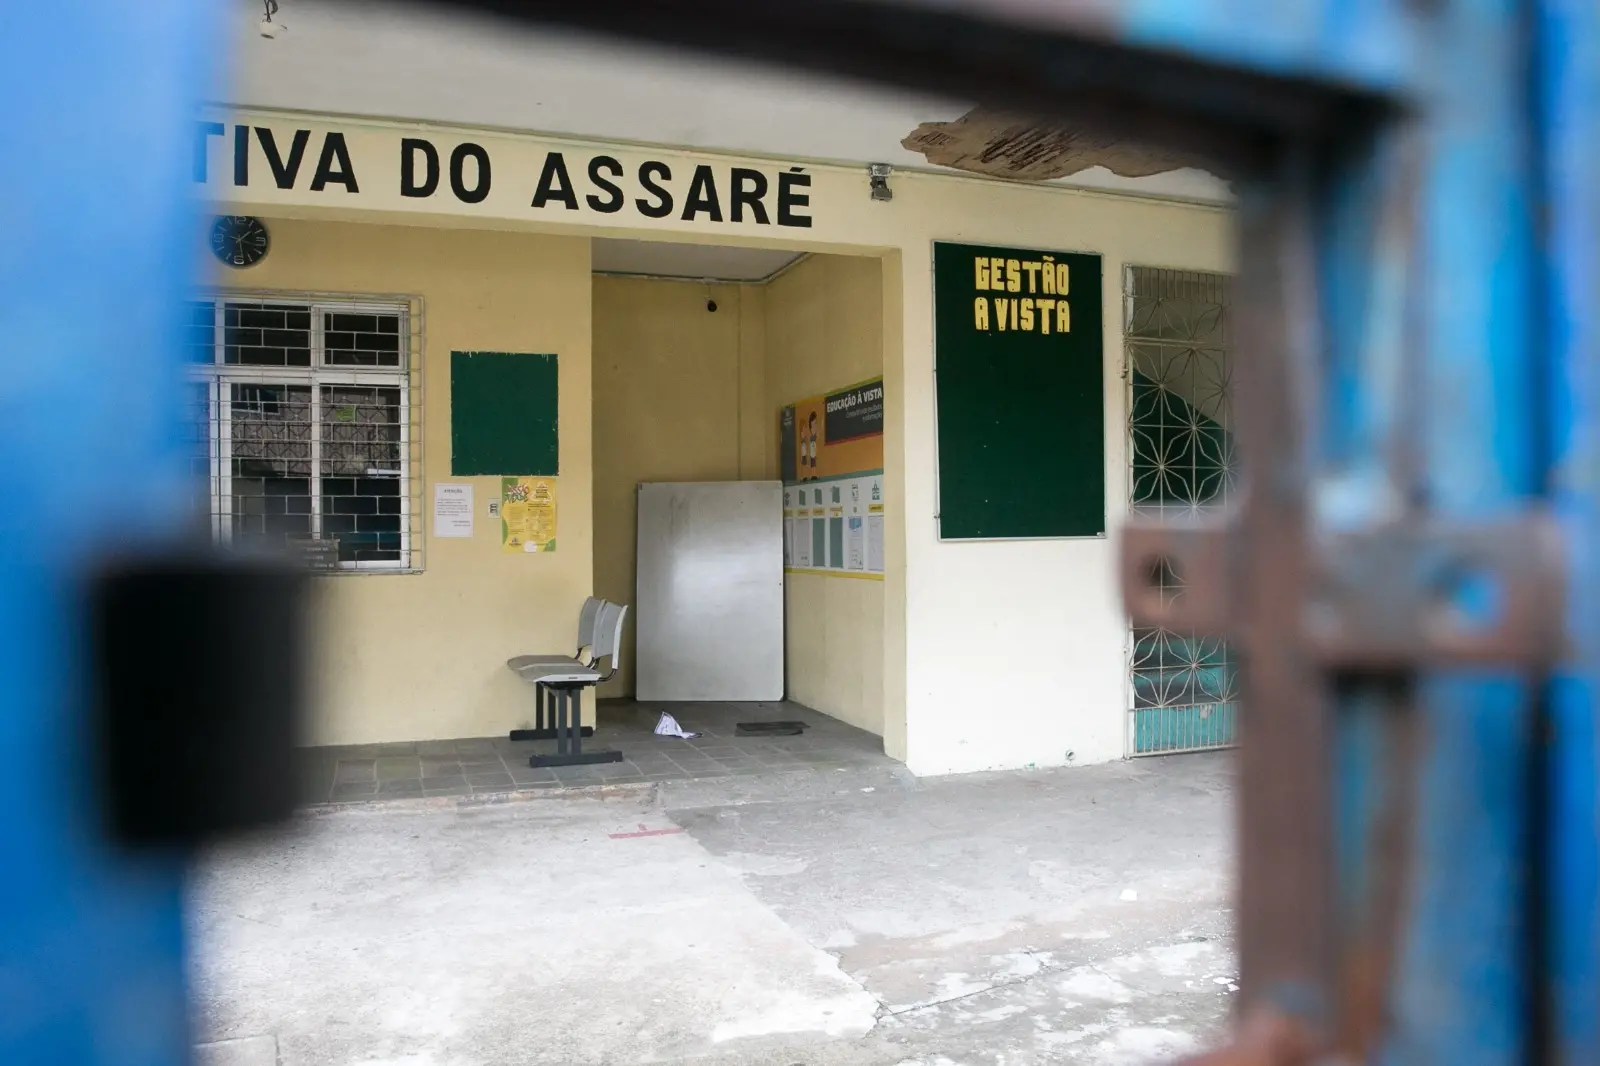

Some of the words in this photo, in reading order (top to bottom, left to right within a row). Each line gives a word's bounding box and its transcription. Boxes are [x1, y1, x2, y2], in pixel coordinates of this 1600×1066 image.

[400, 137, 491, 204] DO
[531, 151, 812, 228] ASSARÉ
[975, 255, 1069, 296] GESTÃO
[974, 296, 989, 331] A
[994, 297, 1070, 335] VISTA
[827, 394, 856, 412] EDUCAÇÃO
[857, 391, 863, 404] À
[863, 388, 882, 402] VISTA
